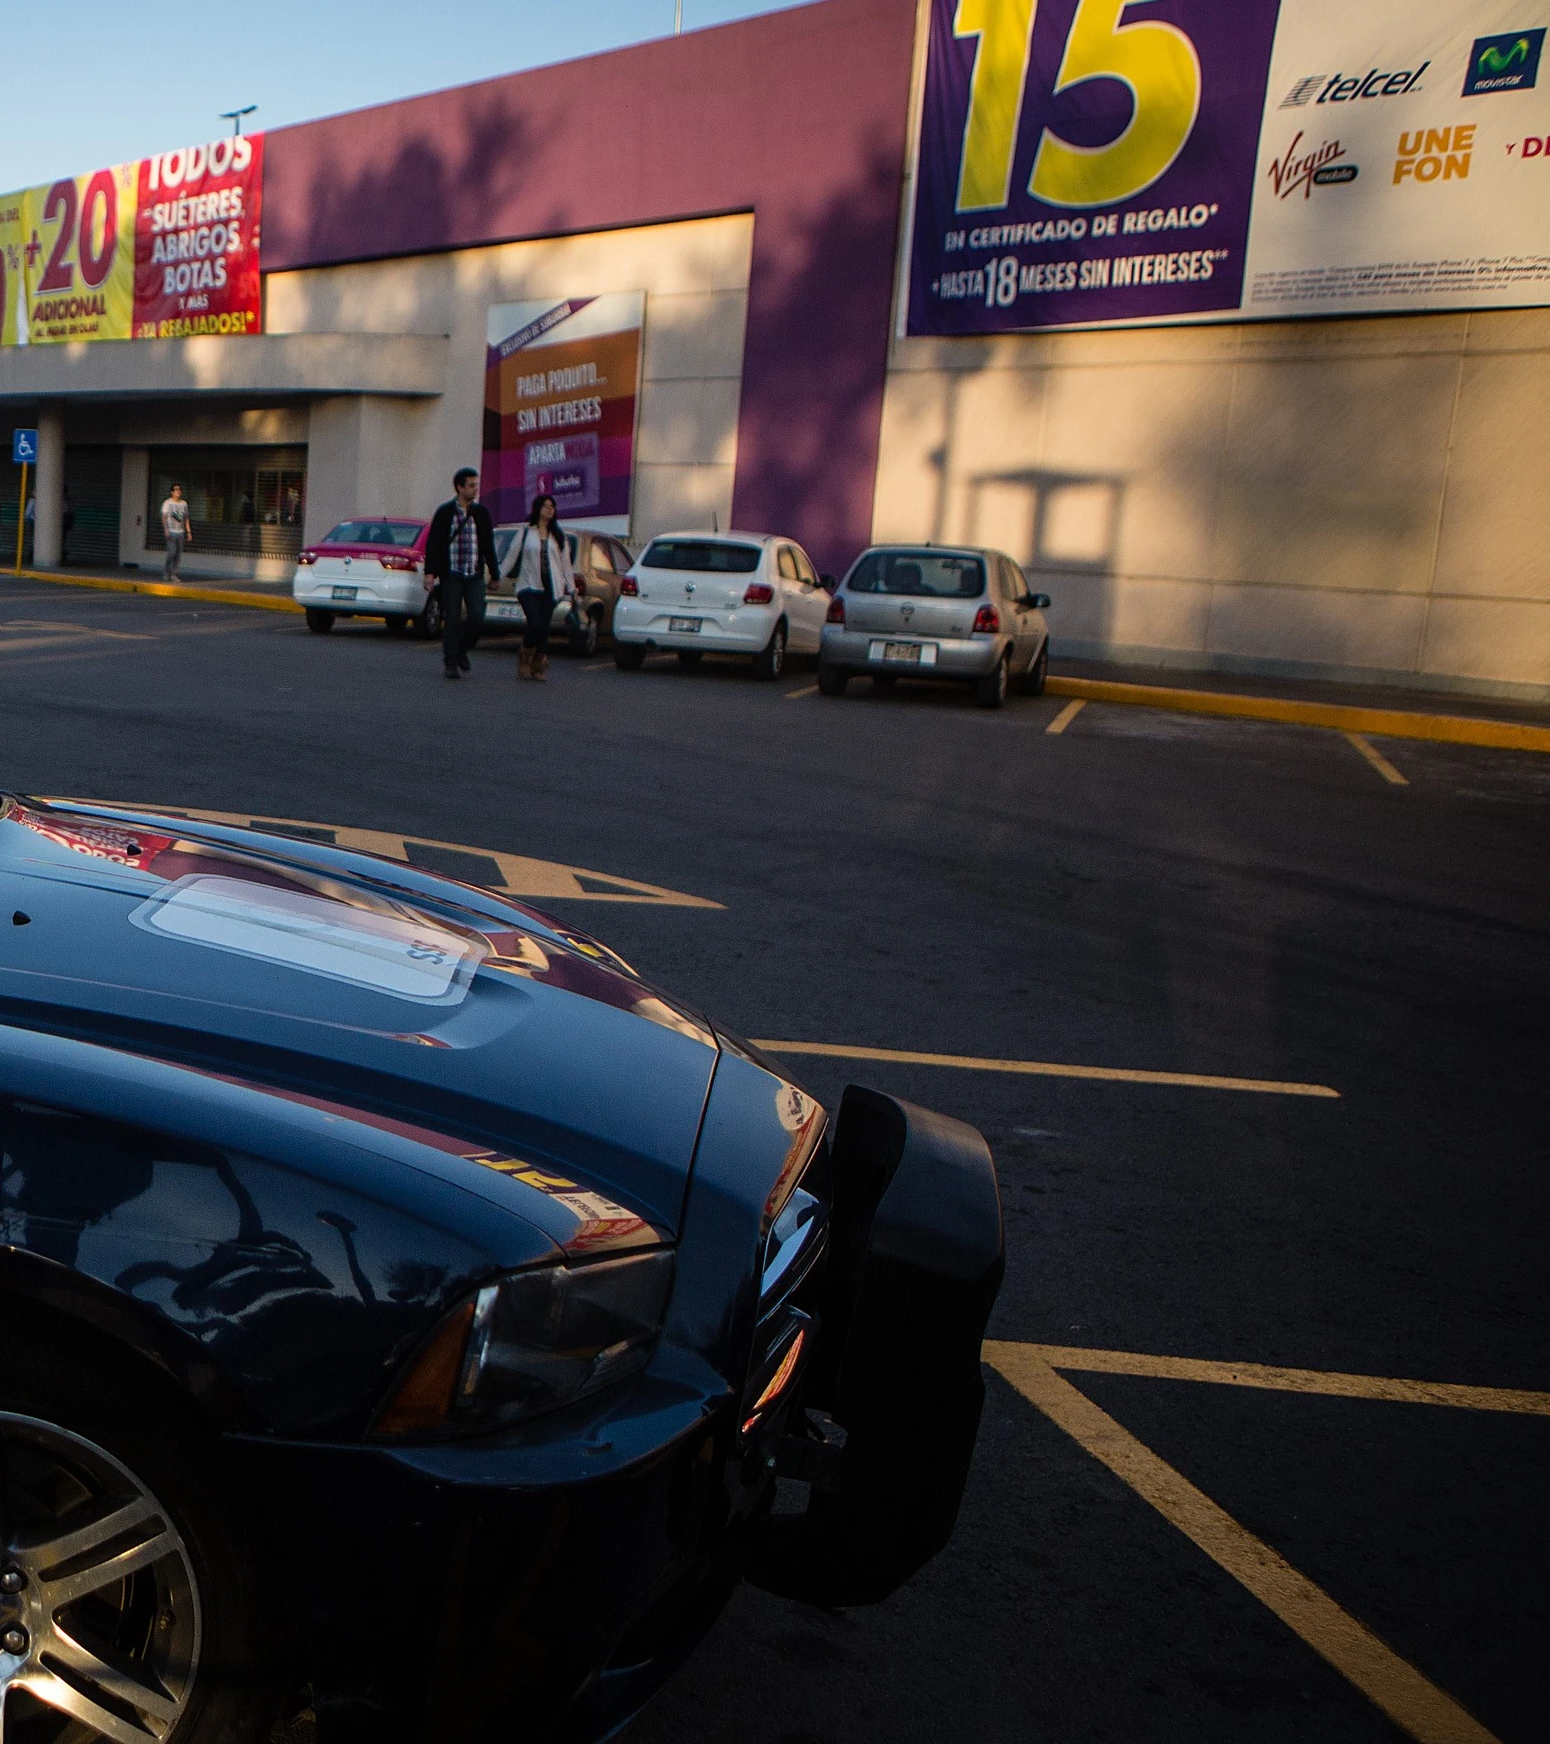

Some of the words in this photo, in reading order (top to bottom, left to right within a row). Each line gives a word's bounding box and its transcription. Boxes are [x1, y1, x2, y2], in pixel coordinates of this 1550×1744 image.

[1315, 60, 1432, 104] telcel
[1474, 74, 1524, 90] movistar
[952, 0, 1202, 214] 15
[1396, 124, 1477, 156] UNE
[1506, 143, 1518, 156] Y
[149, 136, 252, 191] TODOS
[1268, 130, 1346, 200] Virgin
[1392, 152, 1472, 186] FON
[945, 230, 965, 251] EN
[969, 217, 1086, 249] CERTIFICADO
[1091, 213, 1119, 238] DE
[163, 256, 228, 294] BOTAS
[984, 255, 1020, 308] 18
[1019, 262, 1078, 294] MESES
[1079, 258, 1110, 290] SIN
[32, 294, 107, 322] ADICIONAL
[517, 373, 547, 397] PAGA
[517, 409, 537, 434] SIN
[538, 396, 602, 428] INTERESES
